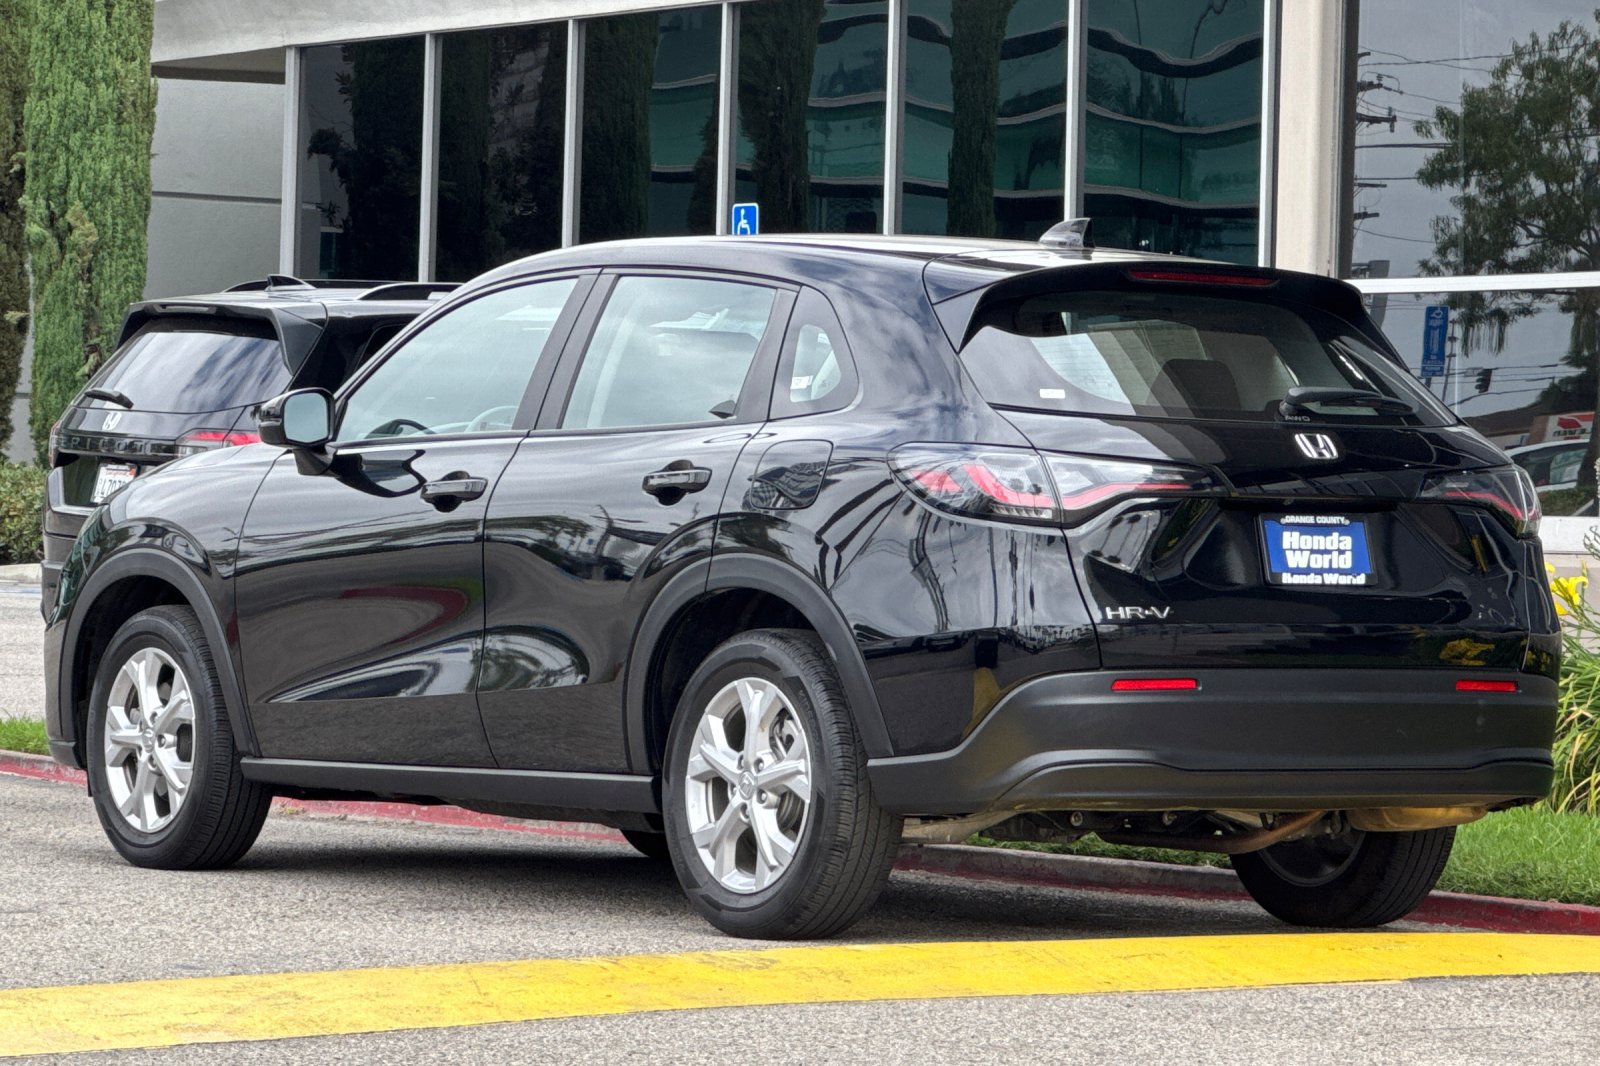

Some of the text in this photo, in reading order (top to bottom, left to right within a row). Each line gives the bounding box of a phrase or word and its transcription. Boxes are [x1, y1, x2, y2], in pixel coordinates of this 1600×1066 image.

[1285, 515, 1345, 524] ORANGE COUNTY
[1282, 531, 1352, 550] Honda
[1285, 550, 1352, 569] World
[1281, 572, 1366, 585] Honda World
[1105, 606, 1171, 620] HR-V
